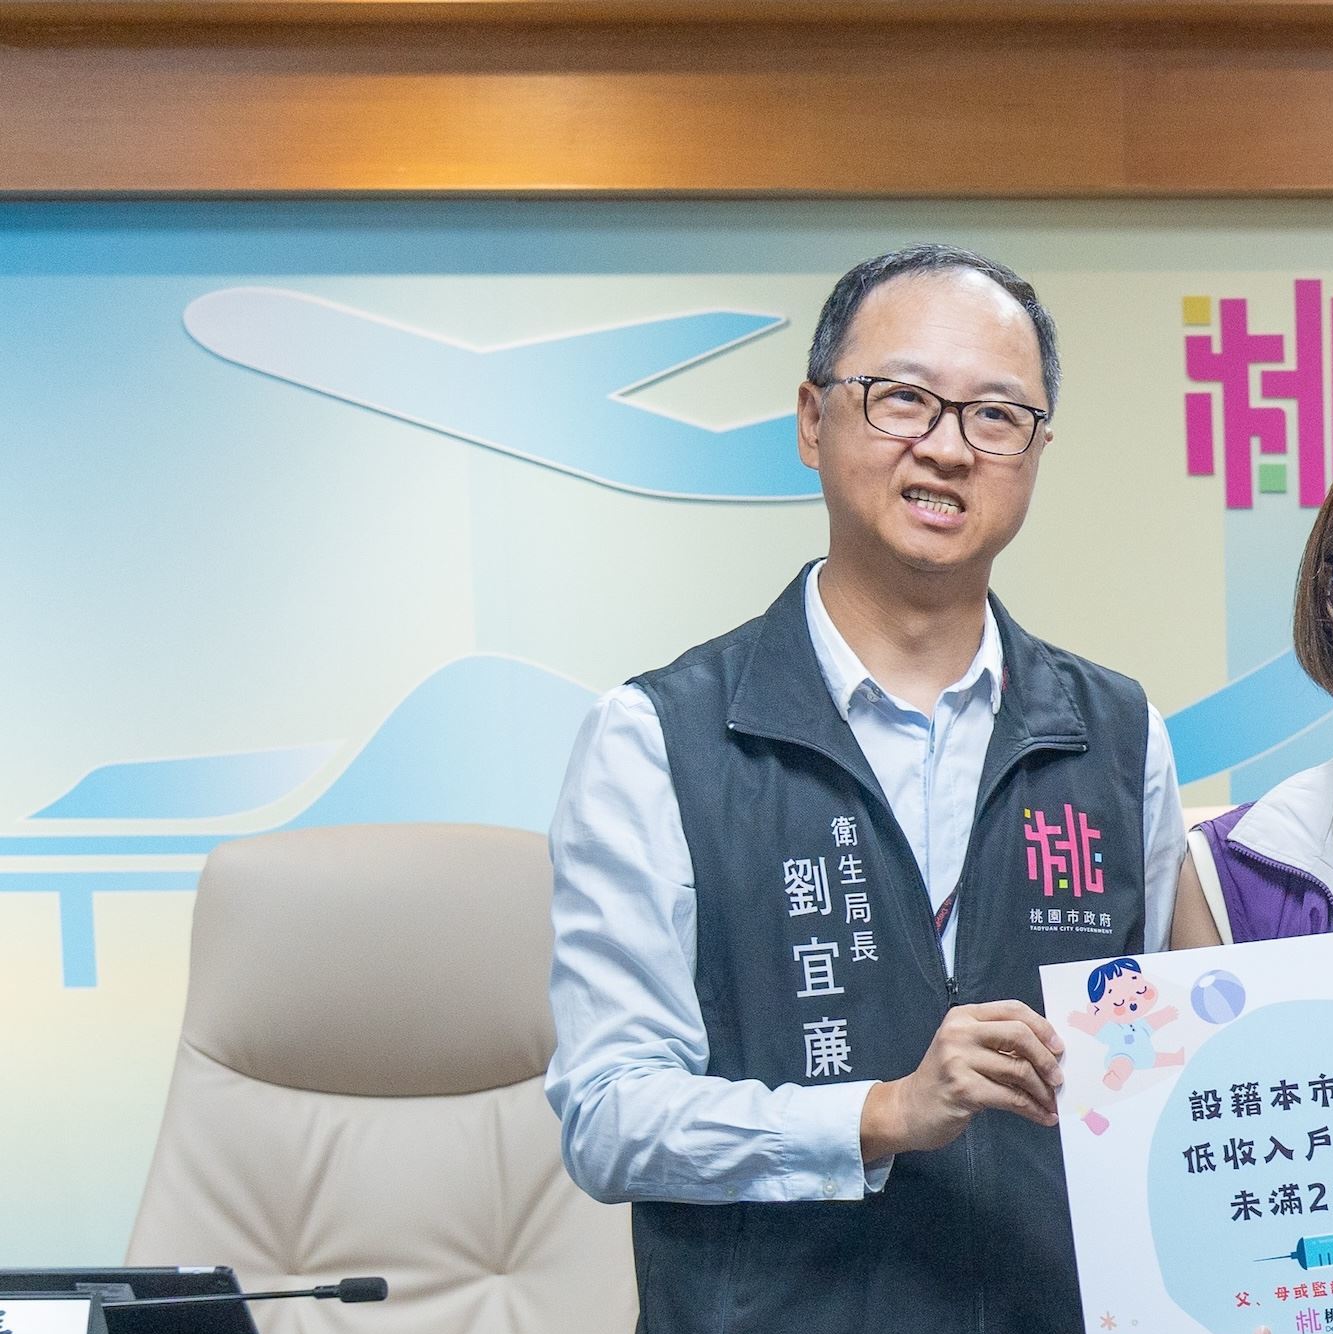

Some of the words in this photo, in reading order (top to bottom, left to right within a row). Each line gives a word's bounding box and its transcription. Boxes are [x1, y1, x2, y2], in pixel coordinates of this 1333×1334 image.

[830, 815, 880, 963] 衛生局長
[1029, 908, 1112, 928] 桃園市政府
[1059, 925, 1074, 933] CITY
[1075, 926, 1113, 935] GOVERNMENT
[782, 856, 853, 1078] 劉宜廉
